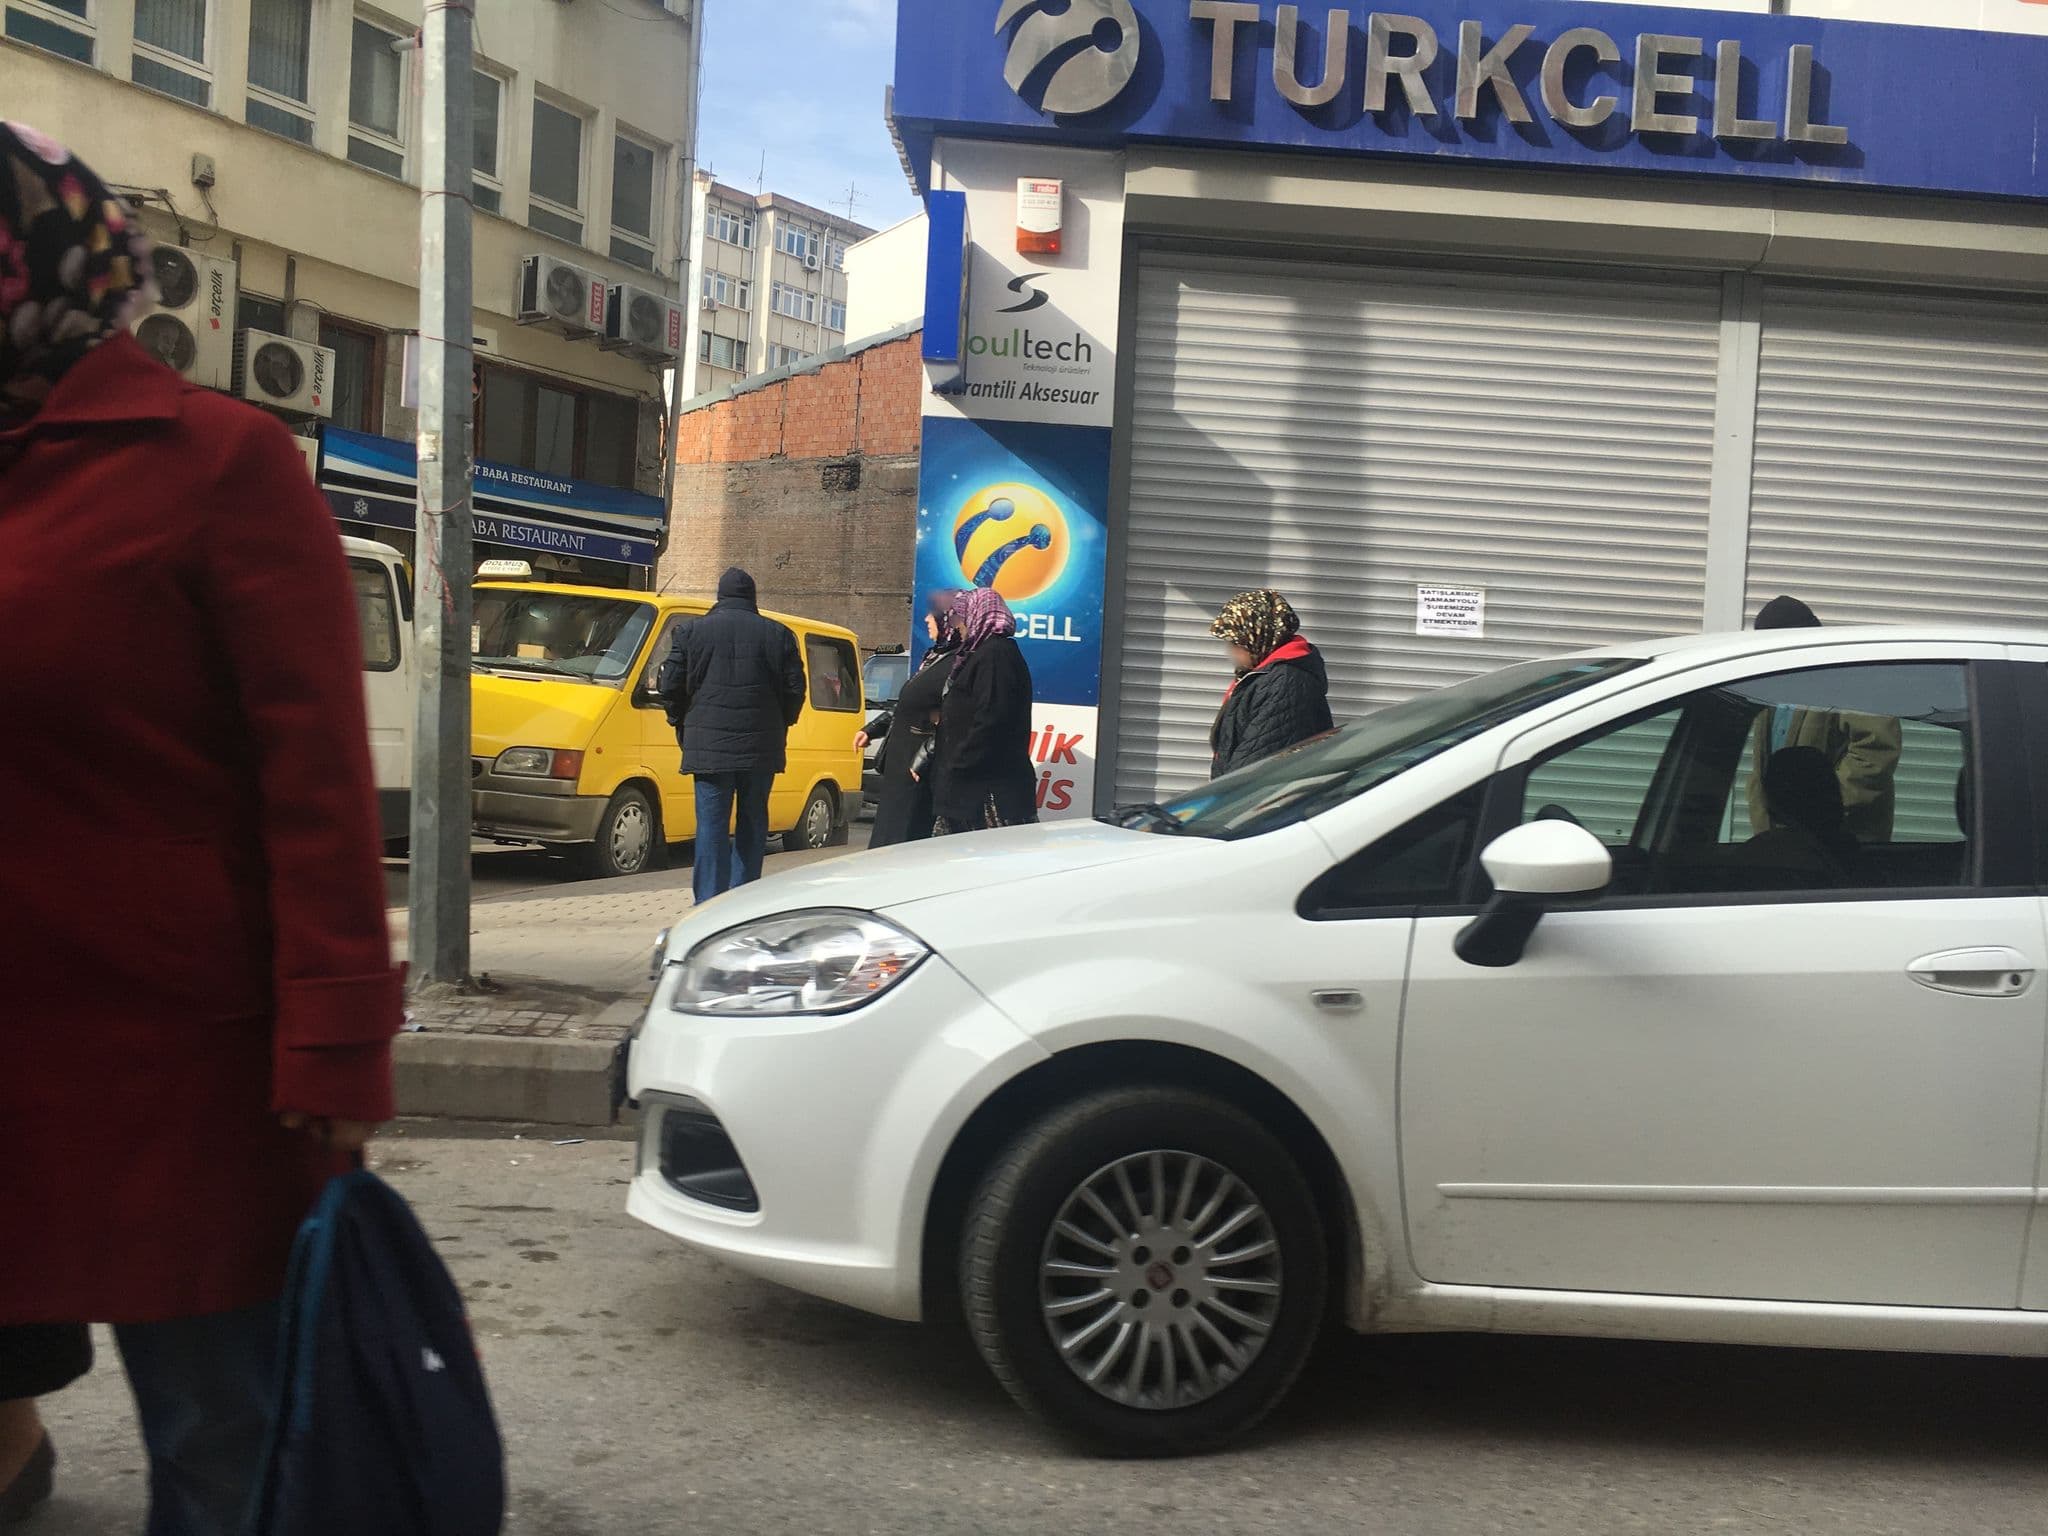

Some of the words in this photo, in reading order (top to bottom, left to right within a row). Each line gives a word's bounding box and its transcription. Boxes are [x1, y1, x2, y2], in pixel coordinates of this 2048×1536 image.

[1190, 0, 1847, 145] TURKCELL
[592, 284, 603, 323] VESTEL
[670, 311, 680, 348] VESTEL
[968, 328, 1091, 362] oultech
[1020, 382, 1100, 405] Aksesuar
[482, 466, 509, 481] BABA
[511, 472, 573, 494] RESTAURANT
[472, 519, 498, 537] ABA
[502, 523, 586, 550] RESTAURANT
[1015, 613, 1081, 642] CELL
